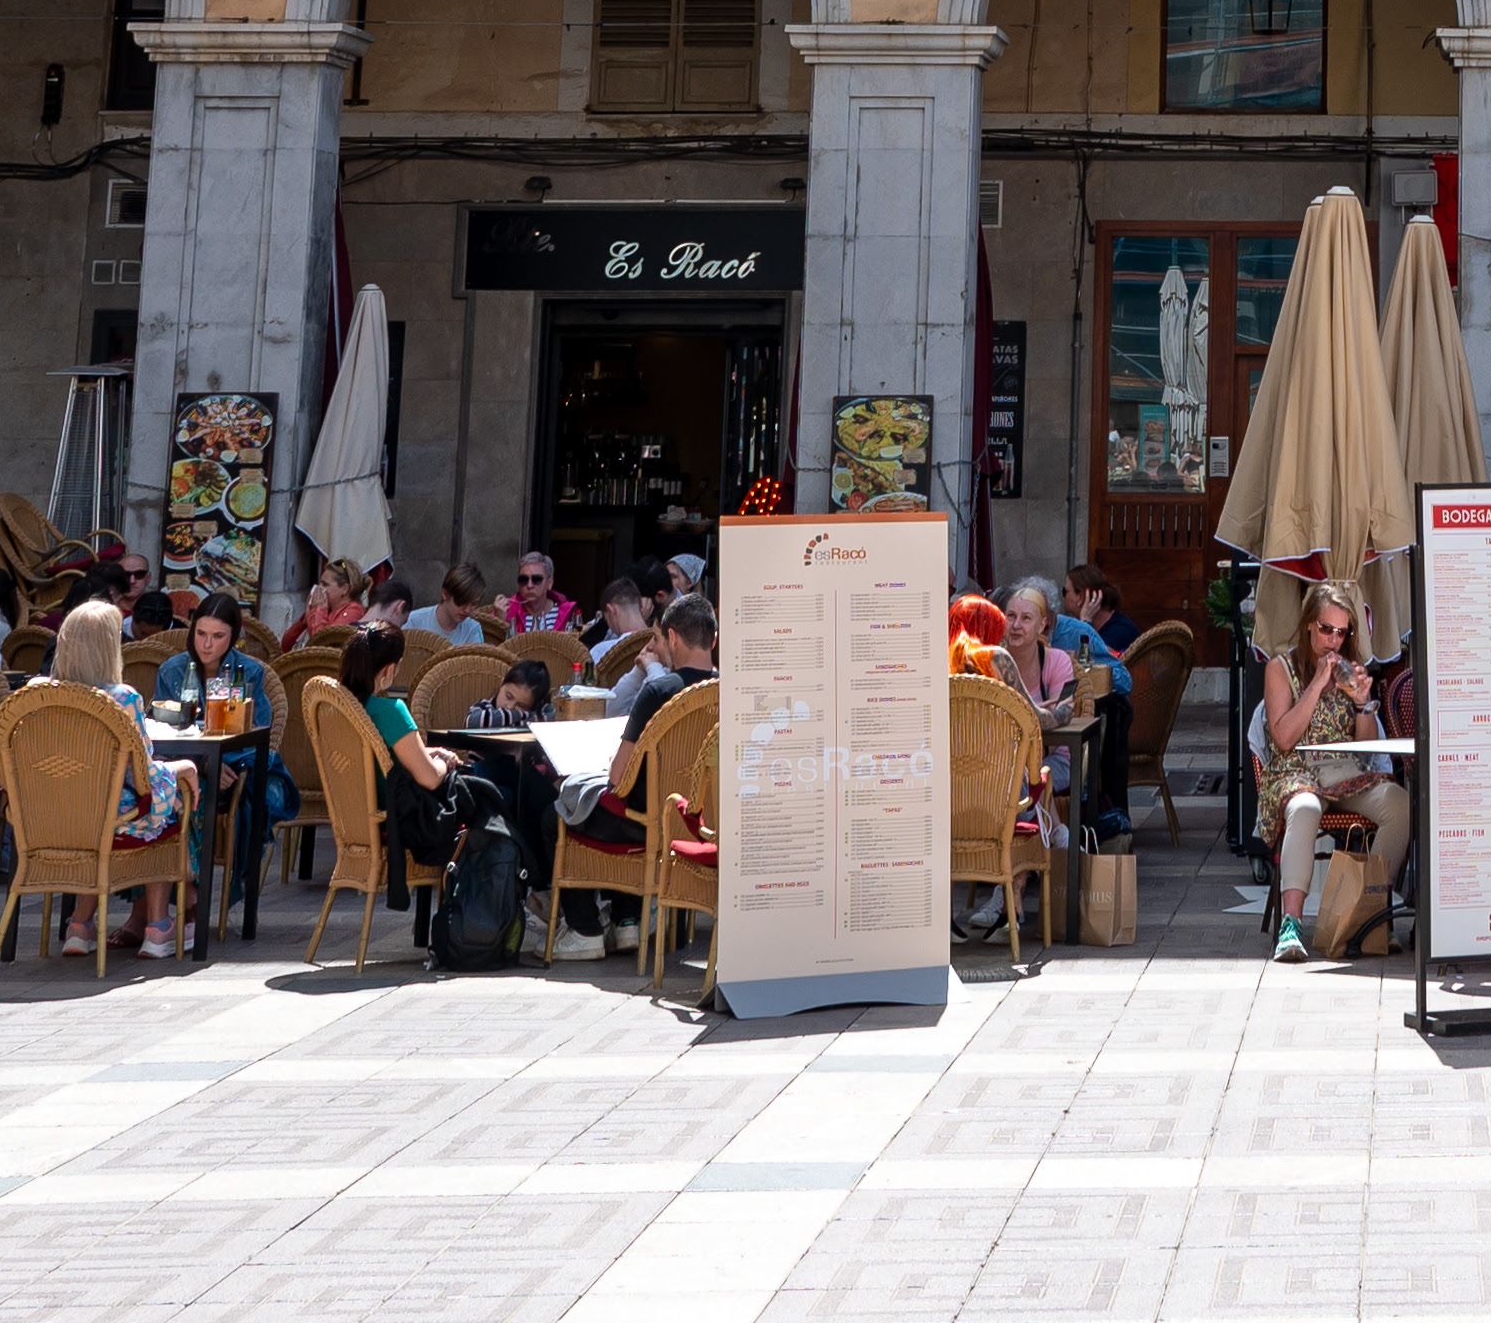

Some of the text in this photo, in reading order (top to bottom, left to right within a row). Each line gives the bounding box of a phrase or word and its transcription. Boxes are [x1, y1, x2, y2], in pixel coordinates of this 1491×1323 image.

[605, 241, 761, 279] Es Racó
[814, 547, 867, 562] esRacó
